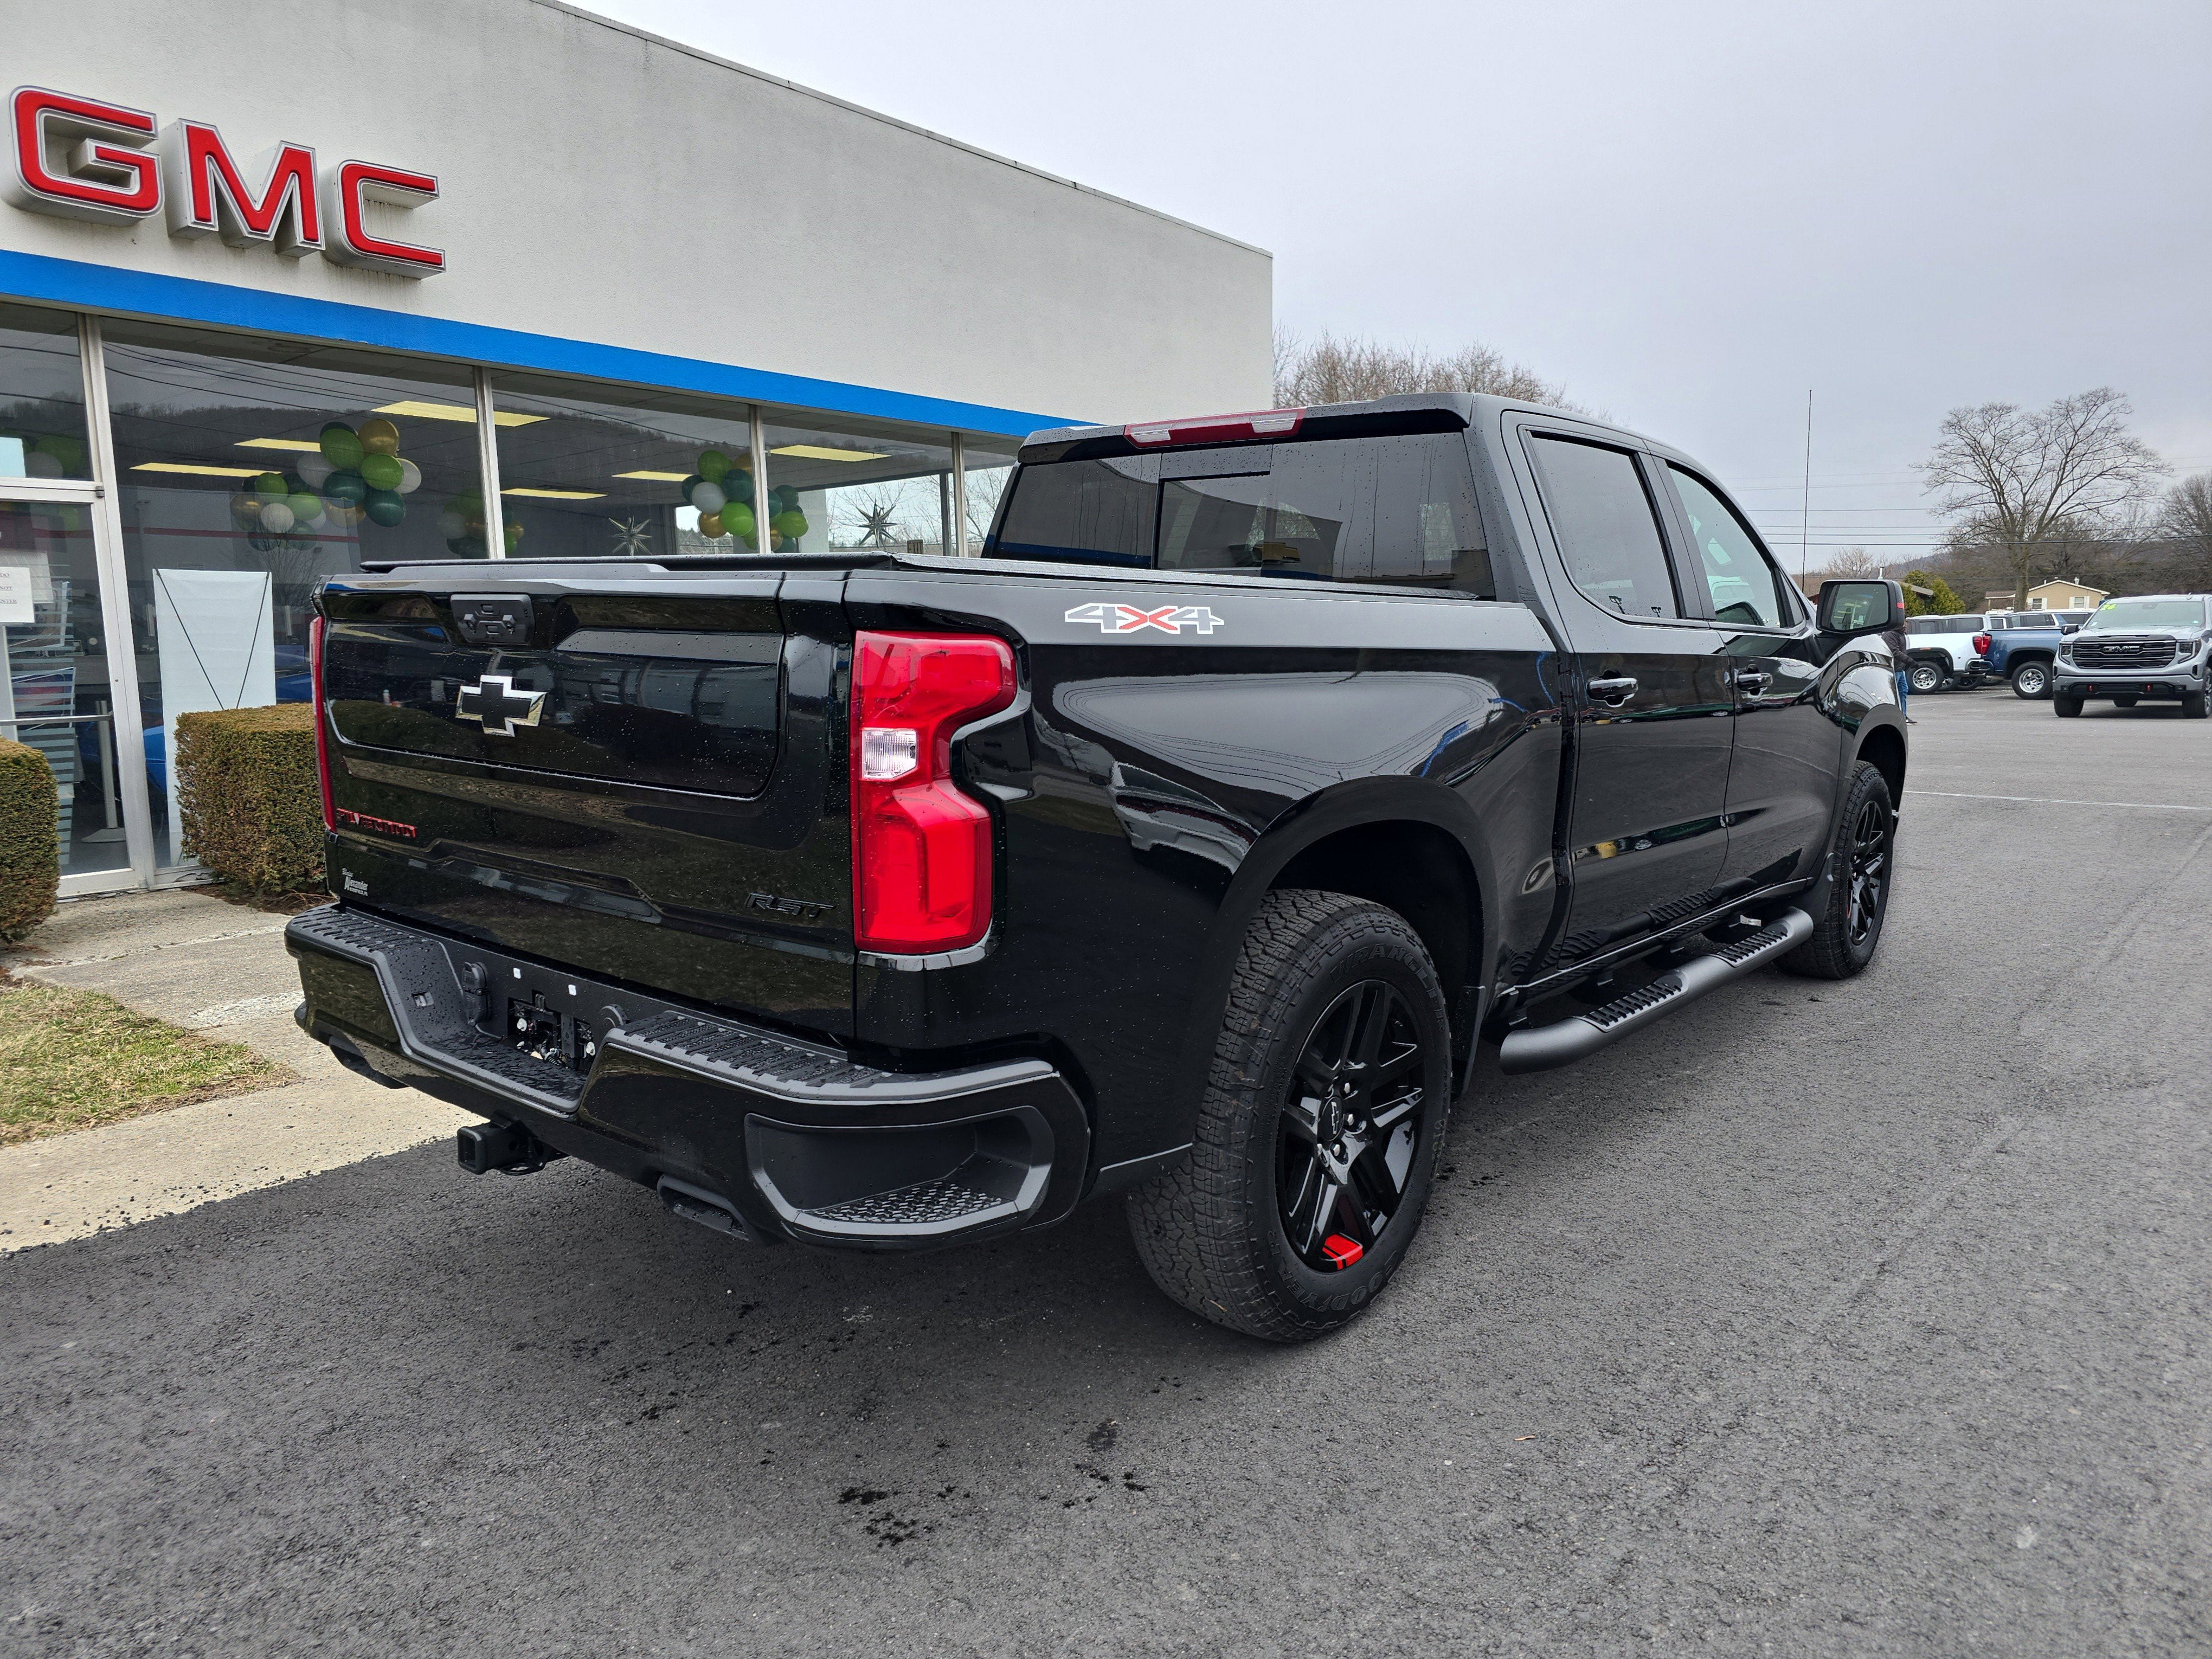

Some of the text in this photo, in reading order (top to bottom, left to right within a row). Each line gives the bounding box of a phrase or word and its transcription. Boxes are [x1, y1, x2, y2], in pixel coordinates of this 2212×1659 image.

[8, 85, 446, 274] GMC
[744, 892, 837, 918] RST
[1329, 943, 1445, 1033] WRANGLER
